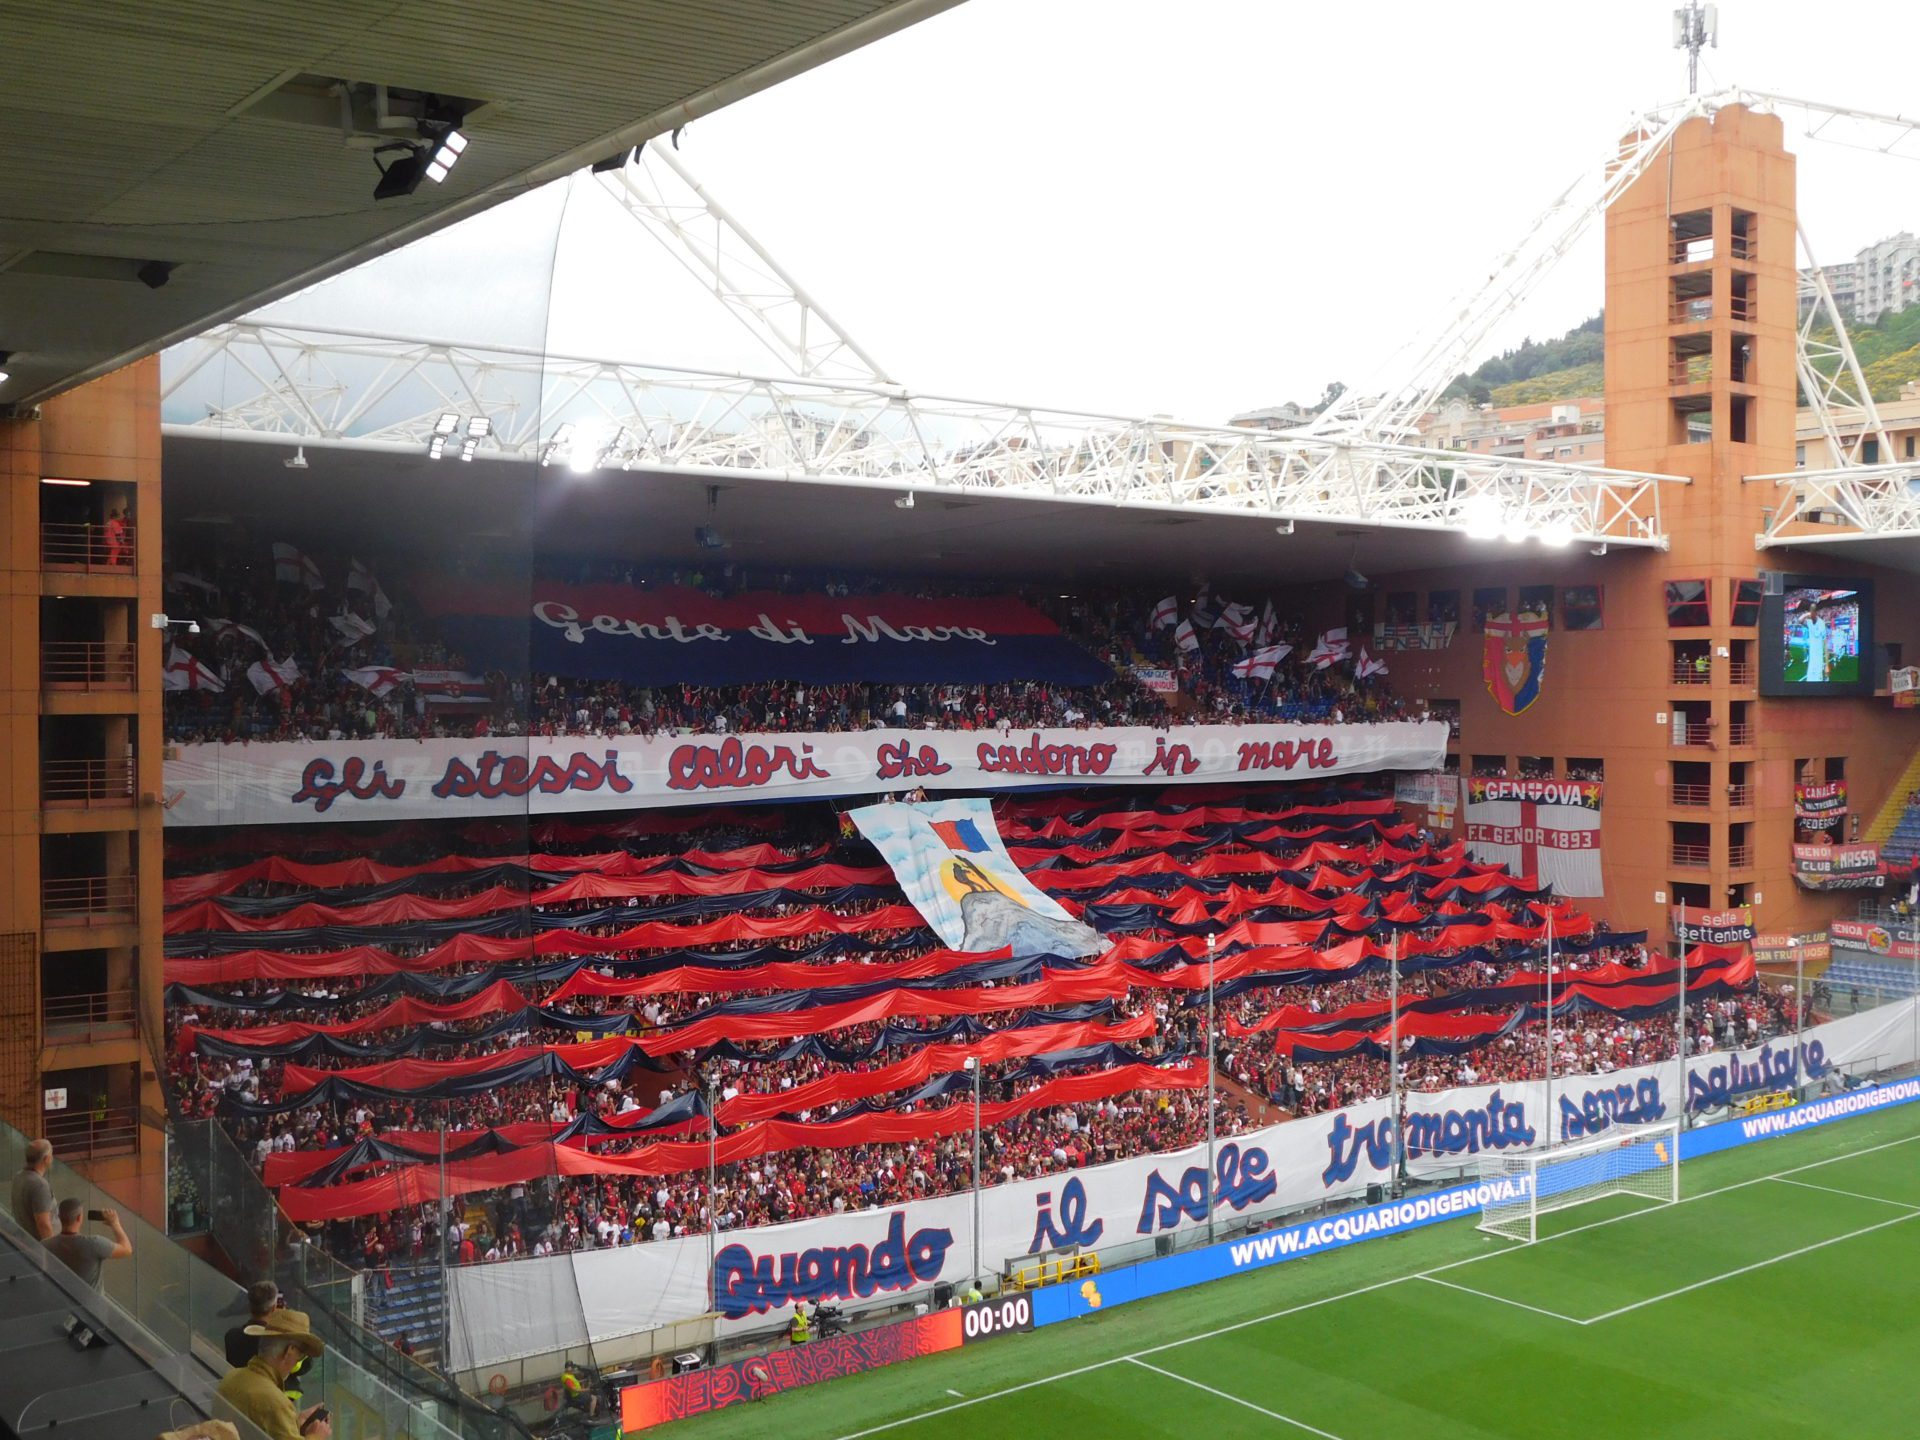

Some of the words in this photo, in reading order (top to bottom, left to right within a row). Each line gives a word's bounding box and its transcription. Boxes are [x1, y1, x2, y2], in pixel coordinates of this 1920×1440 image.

[532, 601, 732, 645] Gente
[747, 613, 814, 646] di
[840, 613, 998, 646] Mare
[432, 750, 633, 798] stessi
[976, 732, 1118, 776] cadono
[1143, 736, 1201, 776] in
[1238, 735, 1339, 771] mare
[1805, 783, 1836, 799] CANALE
[1493, 826, 1545, 846] GENOA
[1551, 830, 1593, 849] 1893
[1801, 860, 1831, 872] CLUB
[1702, 911, 1737, 927] sette
[1757, 934, 1790, 947] GENO
[1799, 932, 1827, 945] CLUB
[1754, 951, 1772, 961] SAN
[711, 1211, 955, 1321] Quando
[1028, 1176, 1104, 1255] il
[1137, 1142, 1278, 1234] sole
[1322, 1089, 1537, 1189] tramonta
[1560, 1076, 1667, 1141] senza
[964, 1298, 1030, 1339] 00:00
